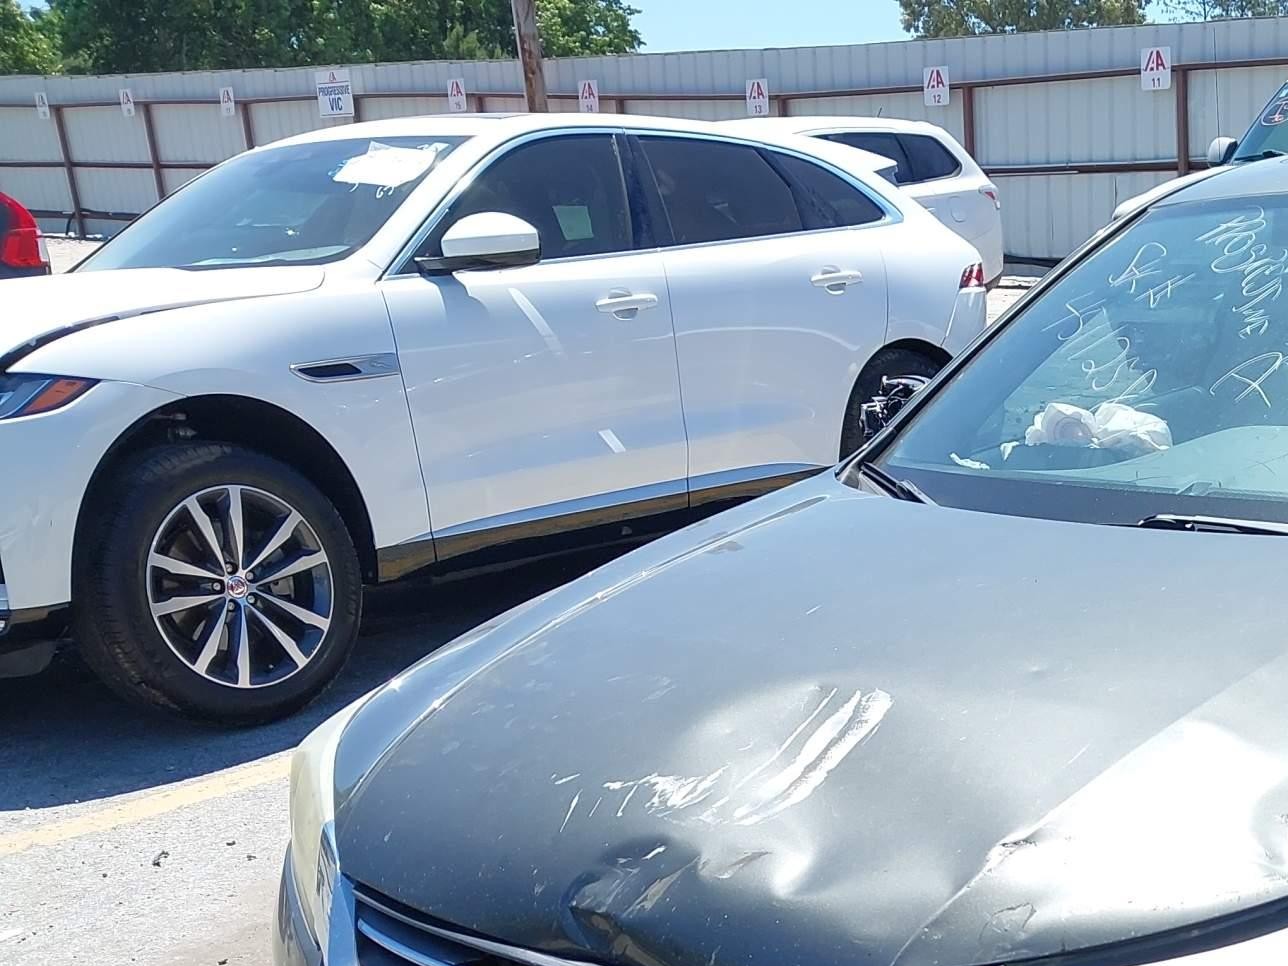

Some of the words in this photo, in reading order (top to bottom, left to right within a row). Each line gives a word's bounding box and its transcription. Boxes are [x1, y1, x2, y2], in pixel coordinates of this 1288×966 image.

[1151, 77, 1162, 89] 11
[318, 85, 351, 96] PROGRESSIVE
[328, 97, 343, 112] VIC
[932, 94, 942, 104] 12
[754, 105, 763, 114] 13
